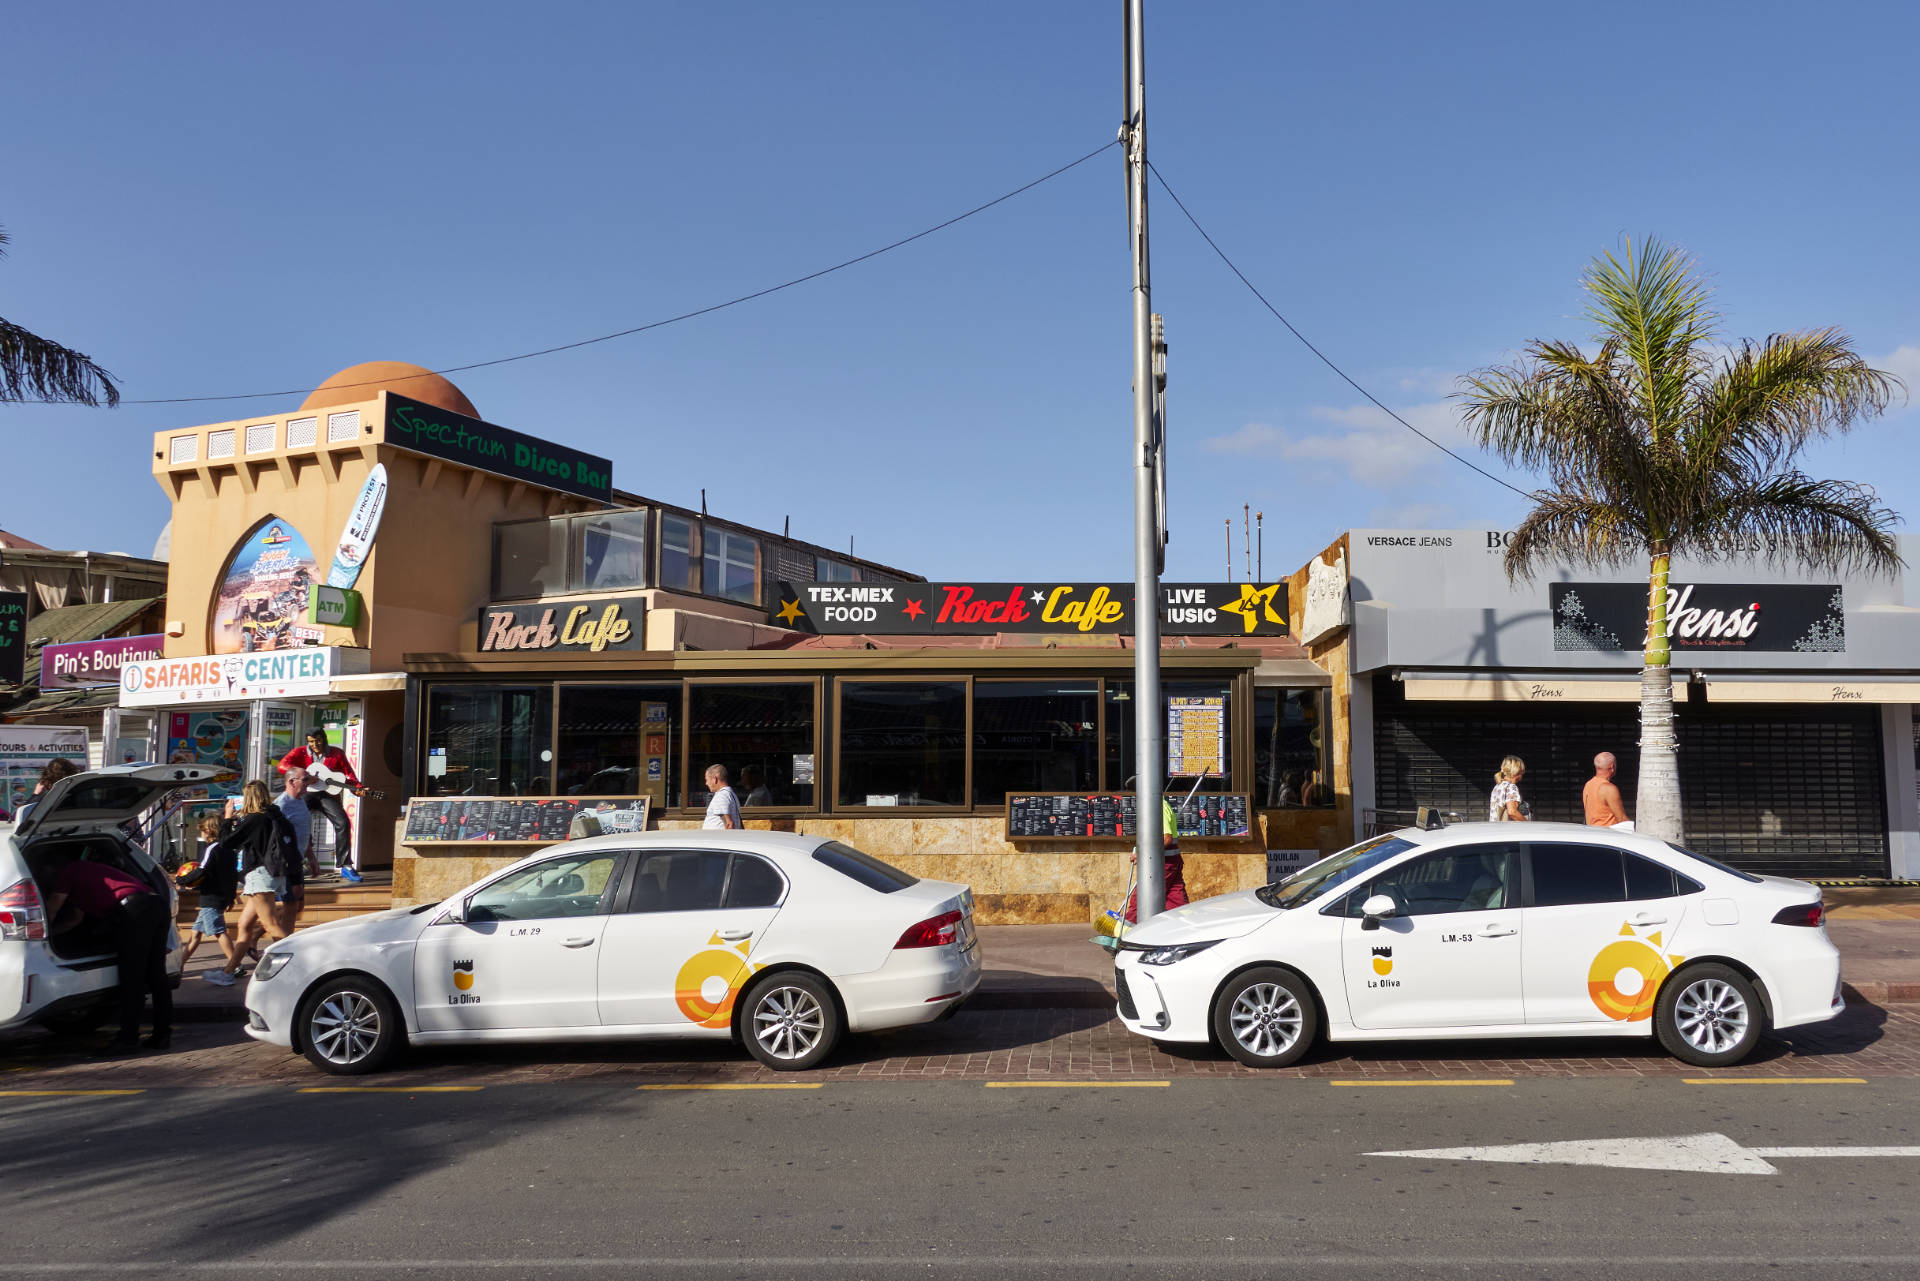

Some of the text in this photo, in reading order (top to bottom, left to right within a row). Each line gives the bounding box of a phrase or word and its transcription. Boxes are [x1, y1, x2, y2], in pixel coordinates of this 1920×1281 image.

[391, 406, 609, 490] Spectrum Disco Bar
[1367, 537, 1452, 547] VERSACE JEANS
[807, 587, 894, 602] TEX-MEX
[1165, 589, 1206, 604] LIVE
[319, 602, 344, 614] ATM
[824, 606, 877, 622] FOOD
[936, 586, 1124, 632] Rock Cafe
[1167, 607, 1217, 623] USIC
[482, 603, 631, 652] Rock Cafe
[54, 651, 90, 675] Pin's
[143, 661, 221, 689] SAFARIS
[245, 652, 325, 683] CENTER
[1531, 684, 1565, 700] Hensi
[1831, 685, 1864, 701] Hensi
[321, 709, 343, 720] ATM
[39, 744, 85, 752] ACTIVITIES
[510, 928, 541, 937] L.M. 29
[1442, 934, 1473, 942] L.M.-53
[1367, 979, 1401, 988] La Oliva
[448, 994, 481, 1005] La Oliva
